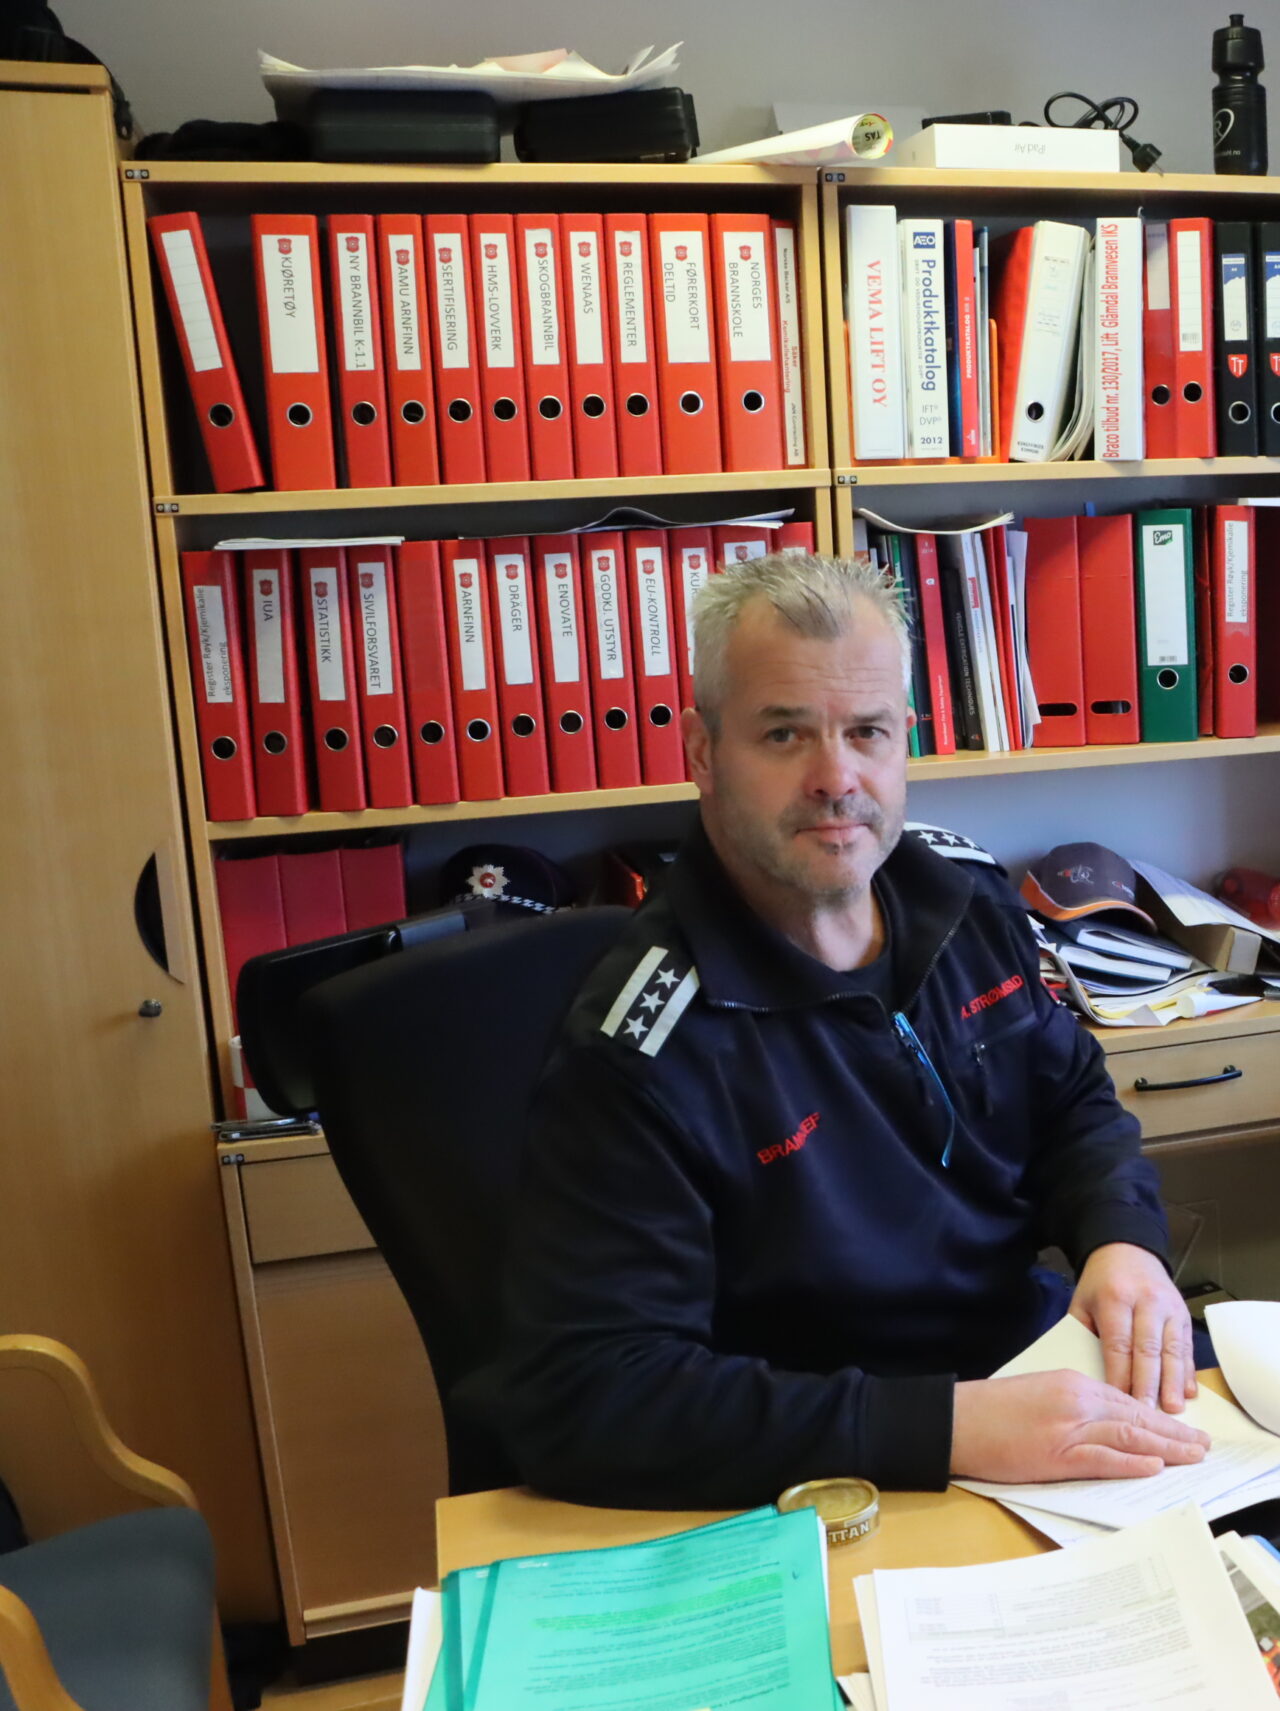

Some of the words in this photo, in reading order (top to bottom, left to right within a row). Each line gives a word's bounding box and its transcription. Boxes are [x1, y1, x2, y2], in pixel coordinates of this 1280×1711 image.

[1014, 143, 1026, 153] Air
[1027, 143, 1046, 154] iPad
[1101, 223, 1119, 237] IKS
[349, 255, 359, 271] NY
[398, 266, 409, 297] AMU
[664, 262, 676, 303] DELTID
[750, 262, 762, 309] NORGES
[1101, 240, 1119, 290] Brannvesen
[281, 256, 296, 319] KJØRETØY
[350, 272, 364, 336] BRANNBIL
[441, 264, 457, 351] SERTIFISERING
[487, 264, 502, 351] HMS-LOVVERK
[537, 259, 557, 352] SKOGBRANNBIL
[581, 262, 594, 314] WENAAS
[623, 261, 637, 347] REGLEMENTER
[686, 262, 700, 331] FØRERKORT
[728, 262, 743, 338] BRANNSKOLE
[866, 260, 884, 321] VEMA
[1100, 292, 1119, 329] Glåmdal
[400, 300, 413, 355] ARNFINN
[922, 259, 941, 391] Produktkatalog
[965, 314, 974, 379] PRODUKTKATALOG
[1101, 332, 1119, 346] Lift
[354, 338, 366, 369] K-1.1
[869, 327, 886, 373] LIFT
[1101, 349, 1122, 392] 130/2017,
[871, 377, 887, 407] OY
[1105, 393, 1119, 405] nr.
[1100, 407, 1119, 432] tilbud
[1103, 433, 1120, 458] Braco
[1227, 522, 1236, 585] Røyk/Kjemikalie
[263, 600, 274, 622] IUA
[461, 590, 476, 643] ARNFINN
[509, 584, 522, 632] DRÄGER
[558, 583, 573, 637] ENOVATE
[600, 574, 612, 615] GODKJ.
[645, 578, 661, 656] EU-KONTROLL
[1227, 586, 1236, 618] Register
[1240, 570, 1248, 617] eksponering
[196, 588, 212, 660] Røyk/Kjemikalie
[317, 599, 332, 663] STATISTIKK
[363, 593, 382, 689] SIVILFORSVARET
[604, 618, 617, 661] UTSTYR
[956, 612, 965, 638] VEHICLE
[205, 661, 217, 697] Register
[218, 642, 232, 696] eksponering
[958, 638, 971, 677] EXTRICATION
[964, 677, 976, 716] TECHNIQUES
[828, 1520, 870, 1543] TTAN
